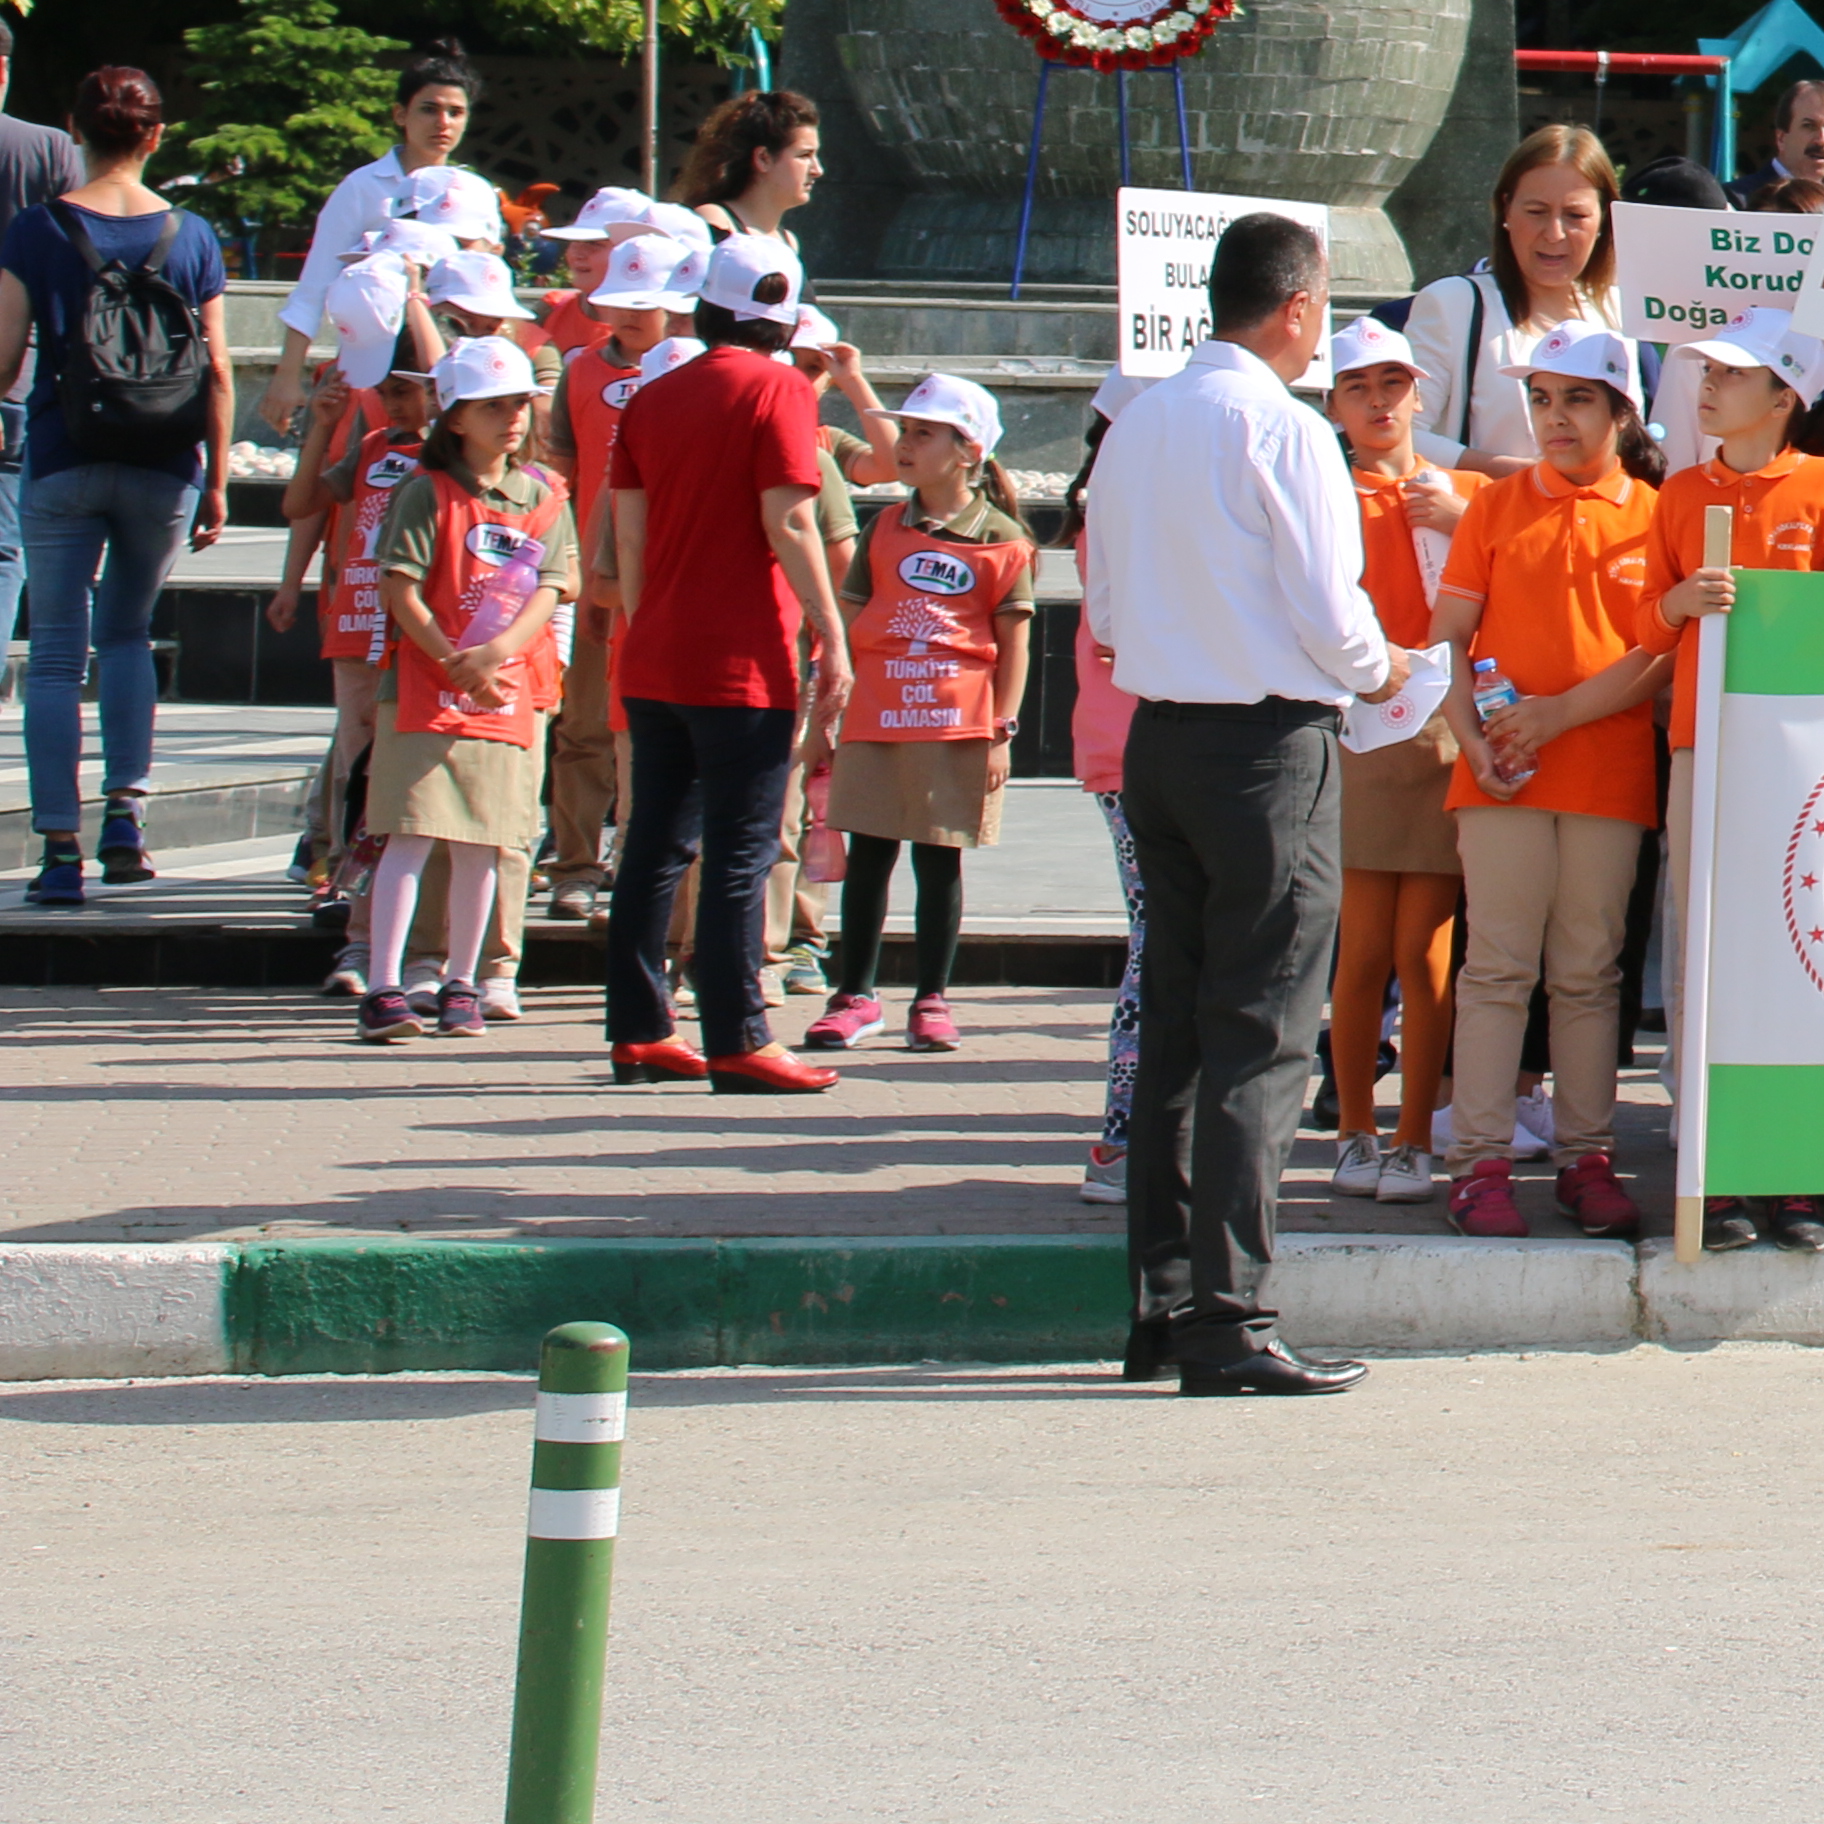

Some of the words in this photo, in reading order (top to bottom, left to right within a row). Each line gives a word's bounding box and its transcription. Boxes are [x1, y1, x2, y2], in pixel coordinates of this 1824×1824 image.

[1710, 228, 1762, 254] Biz
[1644, 296, 1729, 330] Doğa
[1132, 304, 1174, 352] BİR
[915, 557, 957, 583] TEMA
[884, 656, 961, 679] TÜRKİYE
[902, 681, 938, 707] ÇÖL
[880, 708, 963, 729] OLMASIN
